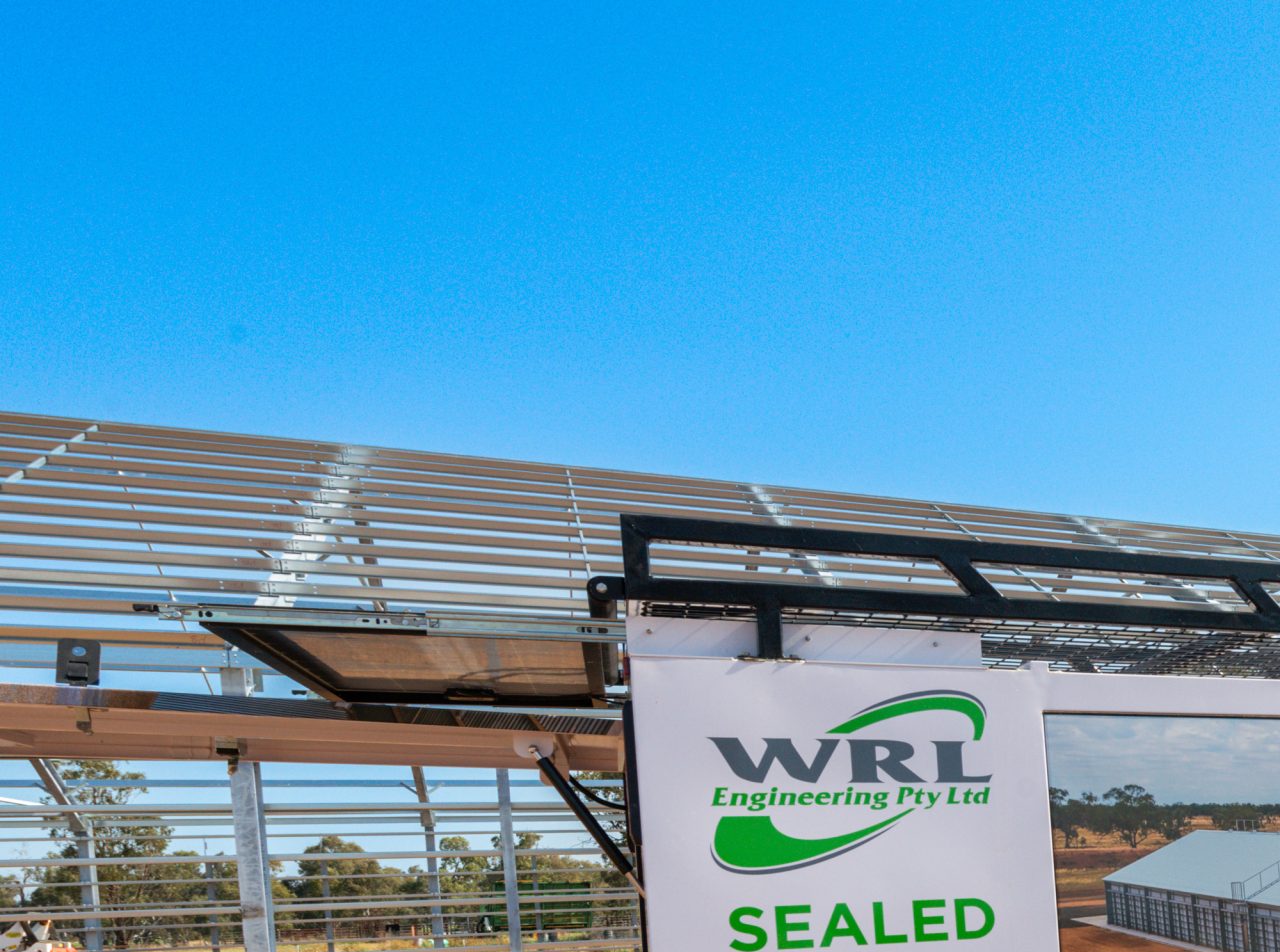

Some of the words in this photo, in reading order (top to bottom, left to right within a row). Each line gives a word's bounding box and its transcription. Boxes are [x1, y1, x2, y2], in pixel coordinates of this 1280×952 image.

[706, 737, 993, 784] WRL
[711, 786, 889, 812] Engineering
[896, 786, 941, 810] Pty
[946, 786, 991, 806] Ltd
[728, 897, 996, 952] SEALED
